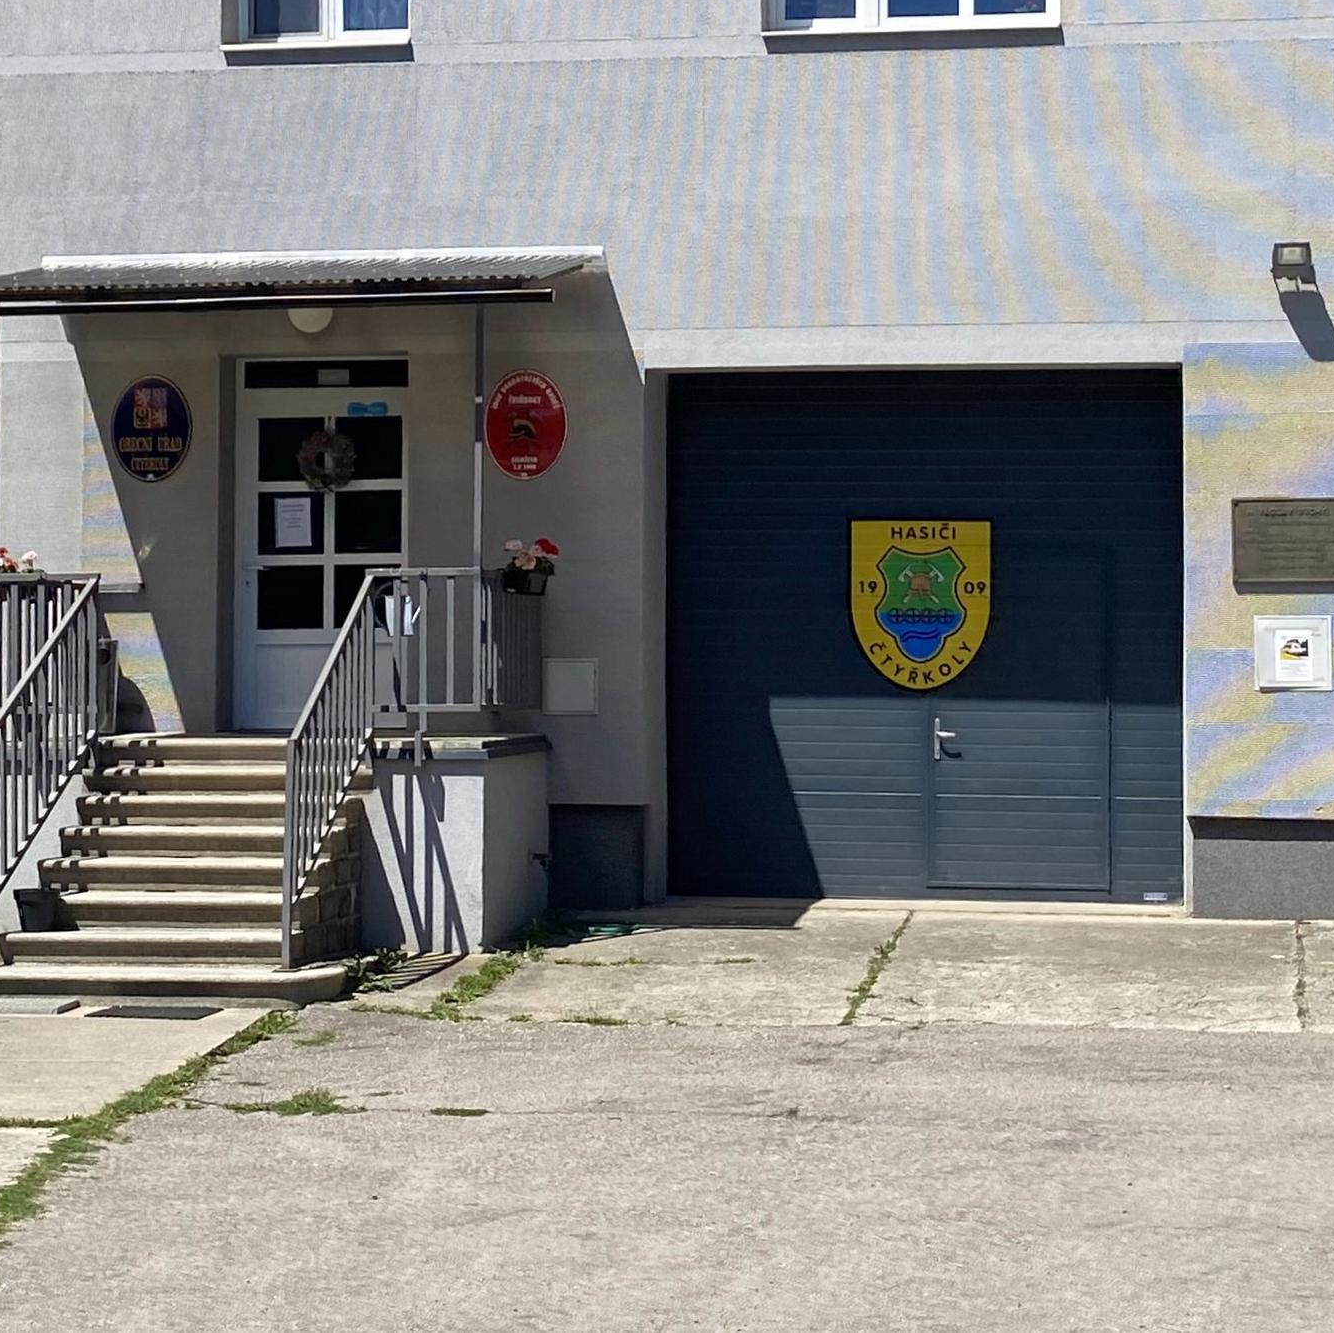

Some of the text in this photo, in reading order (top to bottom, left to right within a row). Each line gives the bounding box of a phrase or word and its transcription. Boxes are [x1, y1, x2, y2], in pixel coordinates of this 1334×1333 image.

[891, 523, 957, 540] HASIČI
[858, 580, 986, 594] 19 09
[869, 641, 972, 684] ČTYŘKOLY
